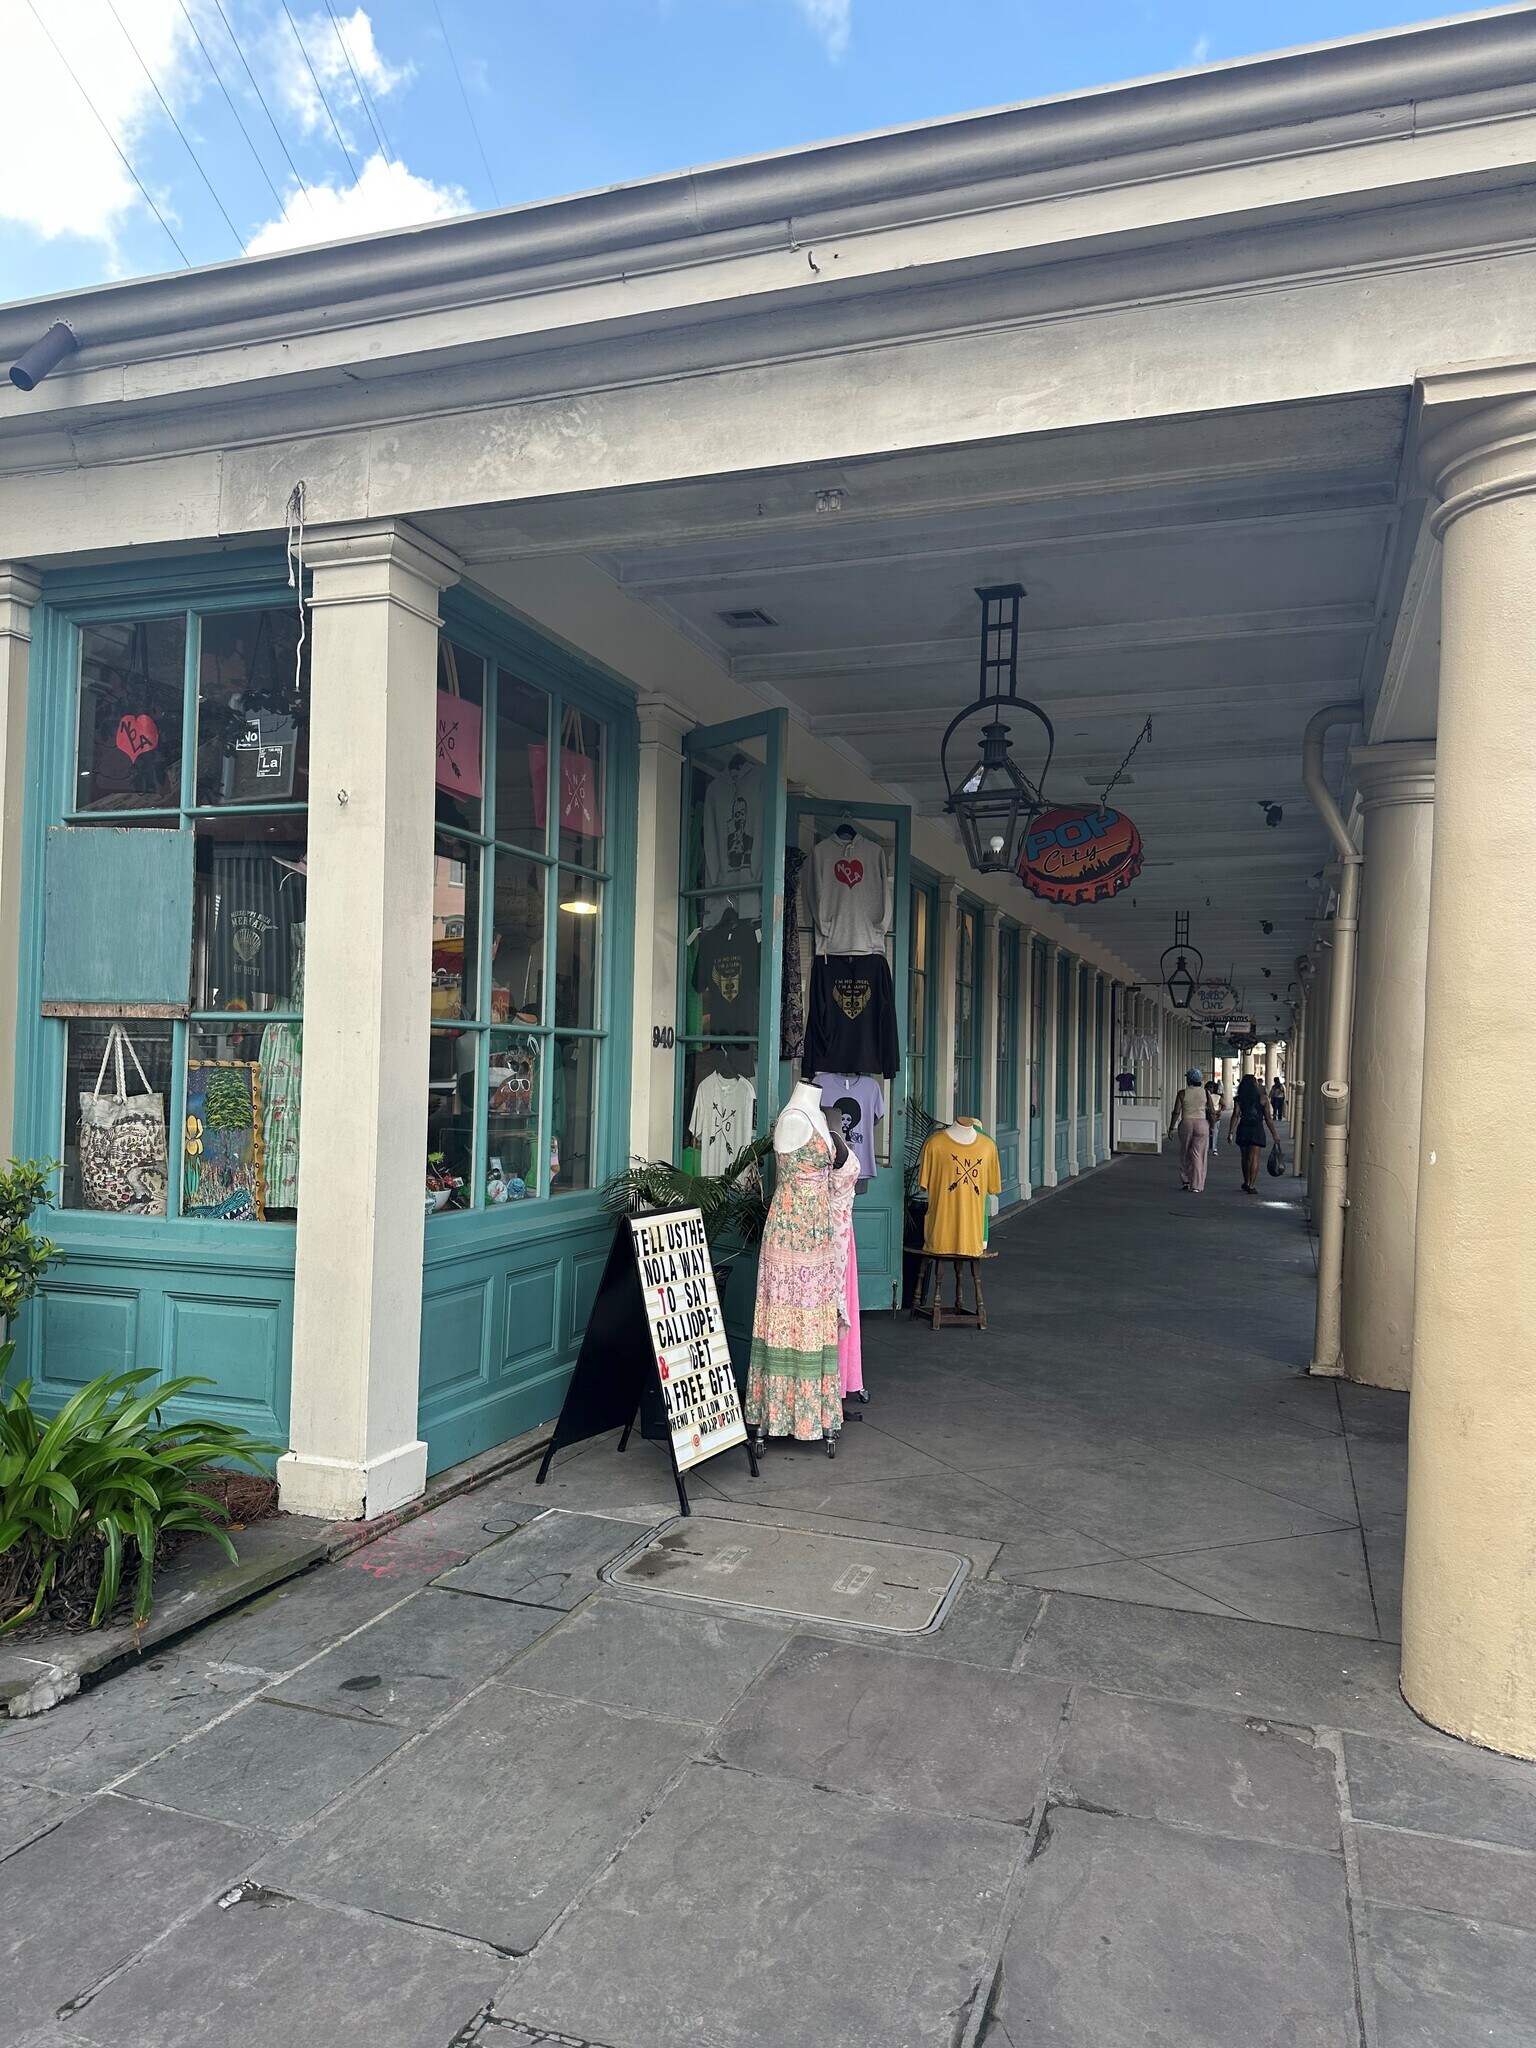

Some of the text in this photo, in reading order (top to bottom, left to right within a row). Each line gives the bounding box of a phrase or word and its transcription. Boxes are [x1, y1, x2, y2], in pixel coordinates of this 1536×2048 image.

[262, 757, 278, 768] La
[1025, 809, 1119, 862] POP
[1043, 839, 1129, 873] City
[1198, 990, 1229, 1000] BABY
[653, 1025, 674, 1049] 940
[632, 1225, 664, 1257] TELL
[643, 1247, 706, 1287] NOLA WAY
[658, 1277, 708, 1315] TO SAY
[658, 1338, 711, 1380] & GET
[663, 1386, 673, 1415] A
[673, 1373, 706, 1411] FREE
